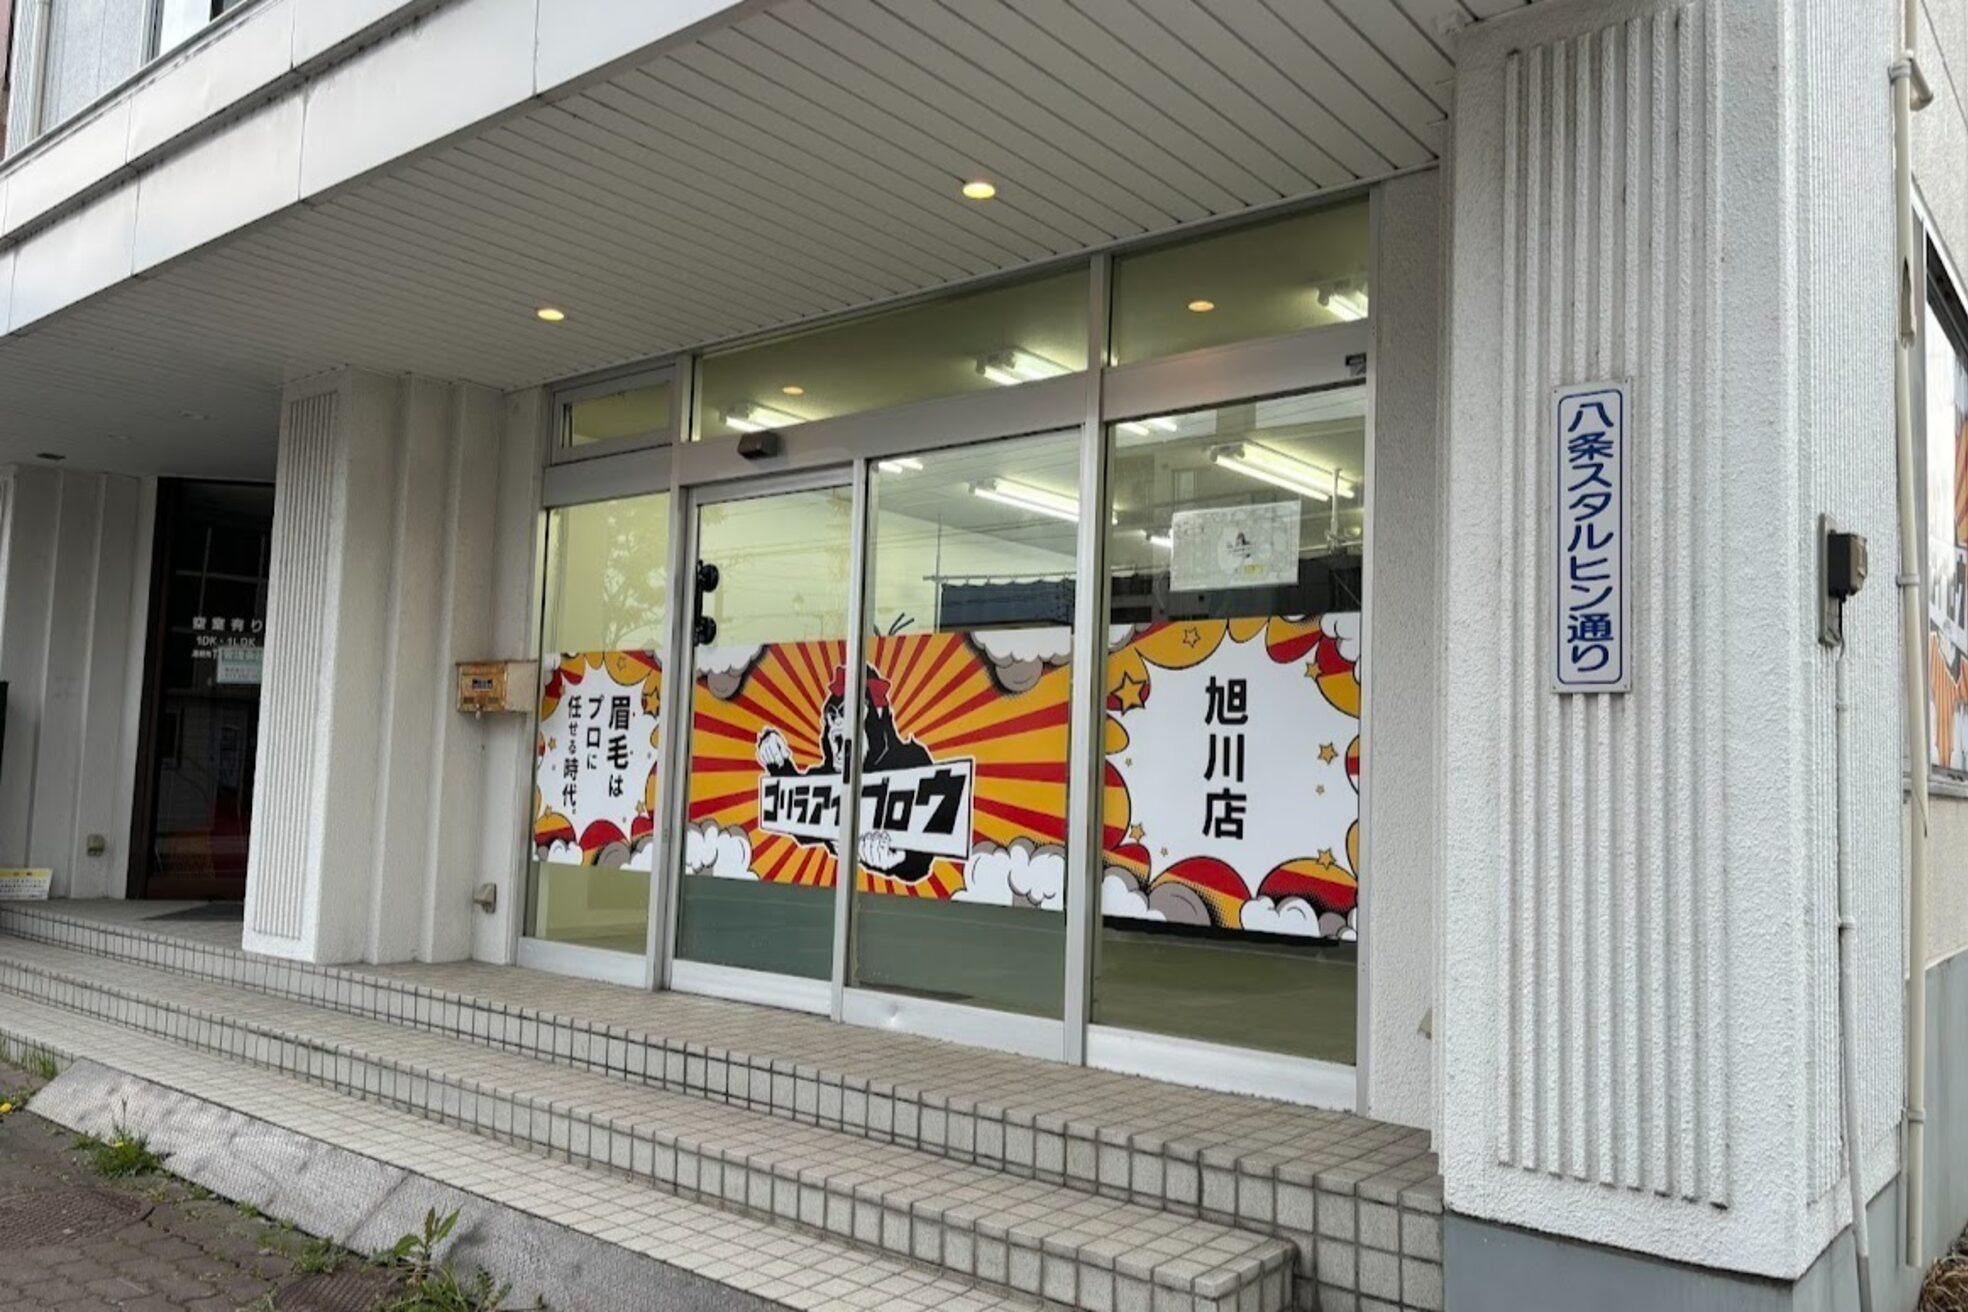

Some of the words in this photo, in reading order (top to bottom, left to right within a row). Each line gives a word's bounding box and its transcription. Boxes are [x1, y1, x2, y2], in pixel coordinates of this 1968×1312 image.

[1567, 401, 1614, 672] 八条スタルヒン通り
[586, 694, 605, 770] プロに
[607, 695, 631, 798] 眉毛は
[1202, 676, 1248, 840] 旭川店
